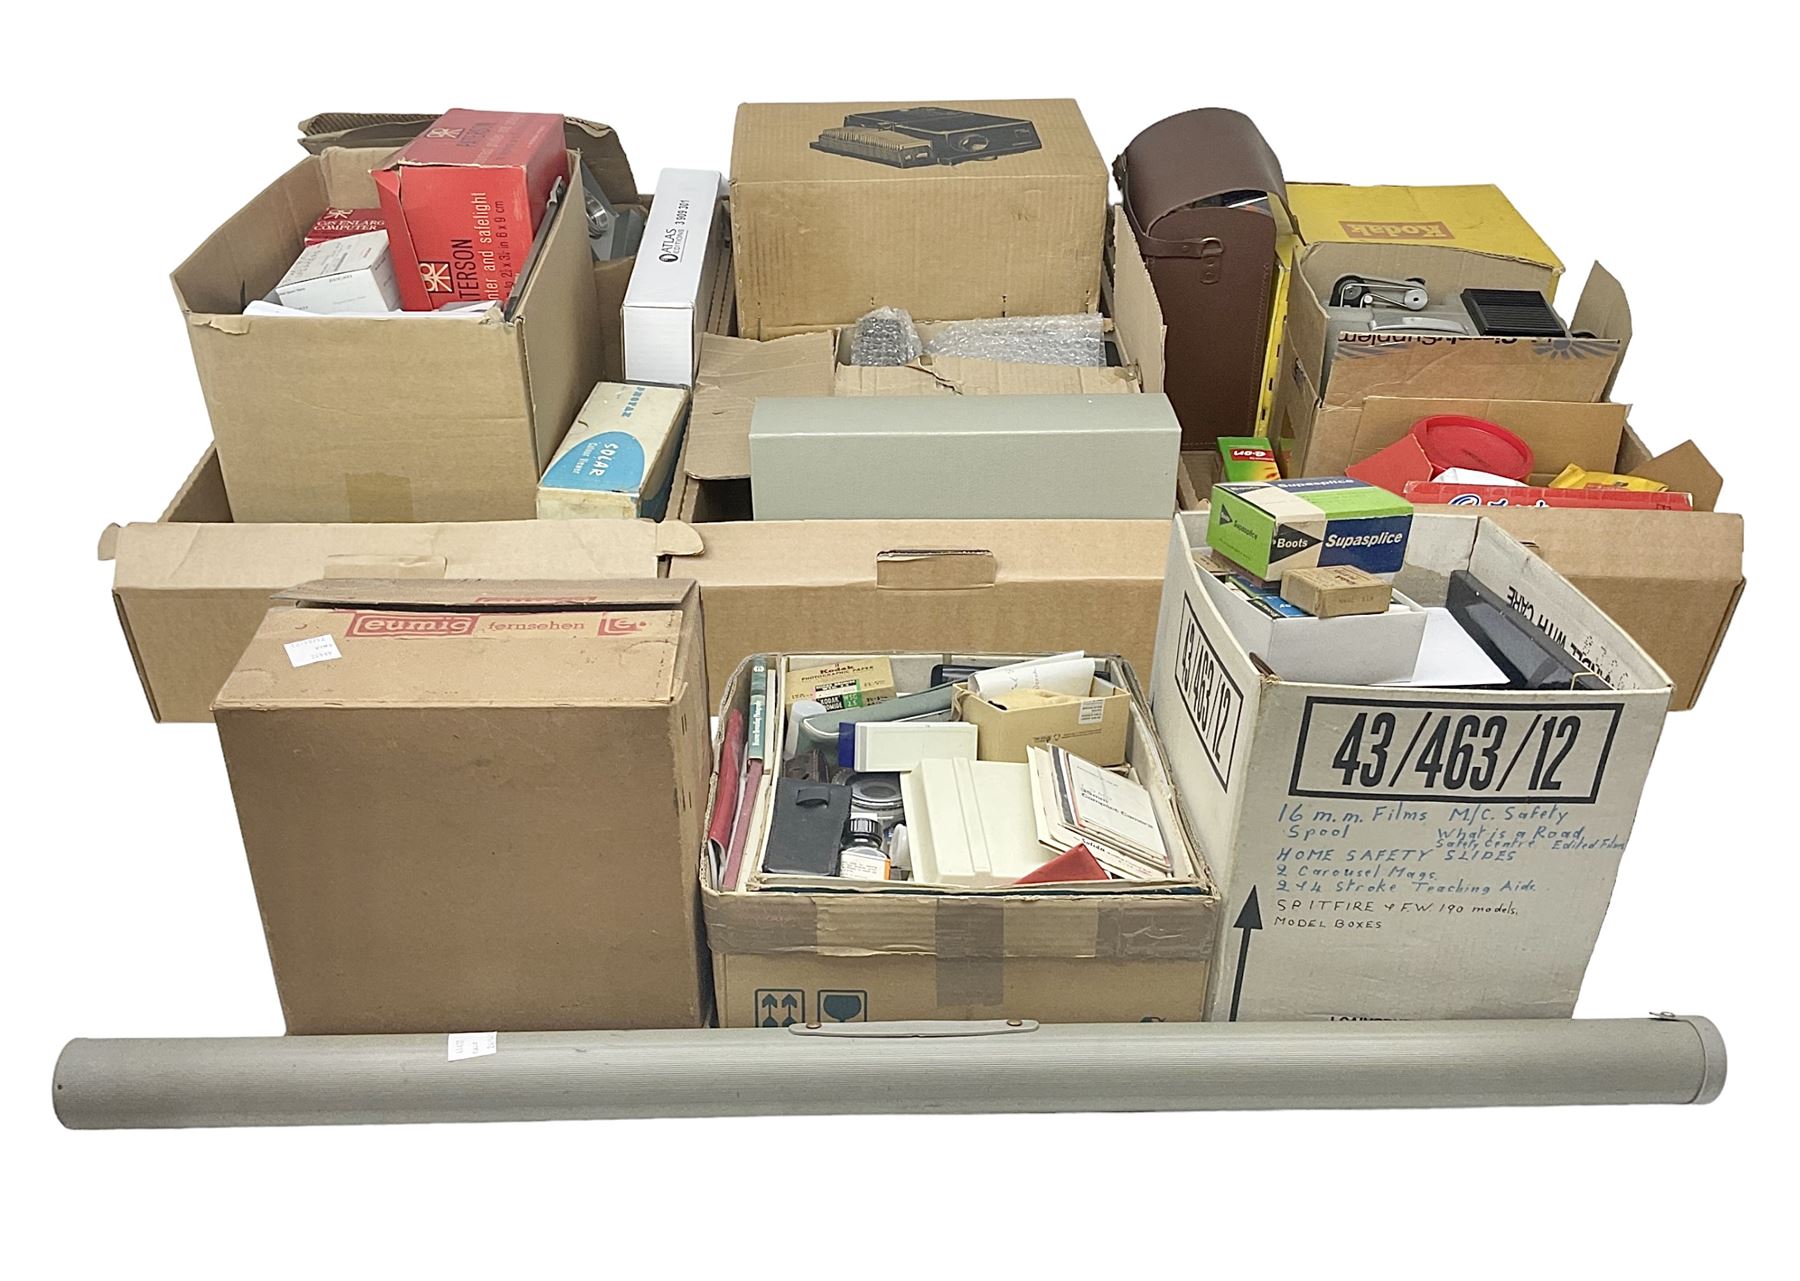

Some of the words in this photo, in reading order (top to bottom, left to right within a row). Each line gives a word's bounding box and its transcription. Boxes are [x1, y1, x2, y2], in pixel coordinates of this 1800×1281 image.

[495, 200, 504, 214] cm
[471, 192, 493, 244] safelight
[1346, 223, 1446, 238] Kodak
[661, 228, 677, 254] ATLAS
[673, 229, 685, 254] EDITIONS
[450, 239, 481, 300] TERSON
[479, 251, 496, 272] and
[588, 442, 619, 477] SOLAR
[1277, 478, 1354, 489] Supasplice
[1276, 538, 1308, 549] Boots
[1325, 531, 1403, 549] Supasplice
[1507, 584, 1534, 622] CARE
[364, 615, 472, 635] eumig
[487, 620, 585, 633] fernsehen
[1536, 614, 1567, 650] WITH
[801, 669, 850, 681] PHOTOGRAPHIC
[820, 665, 854, 675] Kodak
[1181, 617, 1231, 764] 43/463/12
[1331, 711, 1582, 792] 43/463/12
[1278, 803, 1303, 822] 16
[1372, 802, 1428, 821] Films
[1504, 804, 1568, 825] Safety
[1288, 824, 1350, 841] Spool
[1438, 825, 1486, 840] What
[1516, 831, 1526, 839] a
[1533, 826, 1585, 840] Road
[1485, 838, 1536, 849] Centre
[1551, 837, 1599, 850] Edited
[1276, 848, 1335, 861] HOME
[1346, 848, 1433, 862] SAFETY
[1444, 849, 1516, 861] SLIDES
[1277, 864, 1288, 877] 2
[1298, 864, 1381, 878] Carousel
[1388, 866, 1438, 881] Mags.
[1276, 879, 1290, 892] 2
[1310, 881, 1321, 892] 4
[1336, 879, 1397, 893] Stroke
[1411, 878, 1491, 895] Teaching
[1277, 899, 1375, 912] SPITFIRE
[1438, 903, 1465, 914] 190
[1274, 916, 1326, 928] MODEL
[1334, 919, 1382, 929] BOXES
